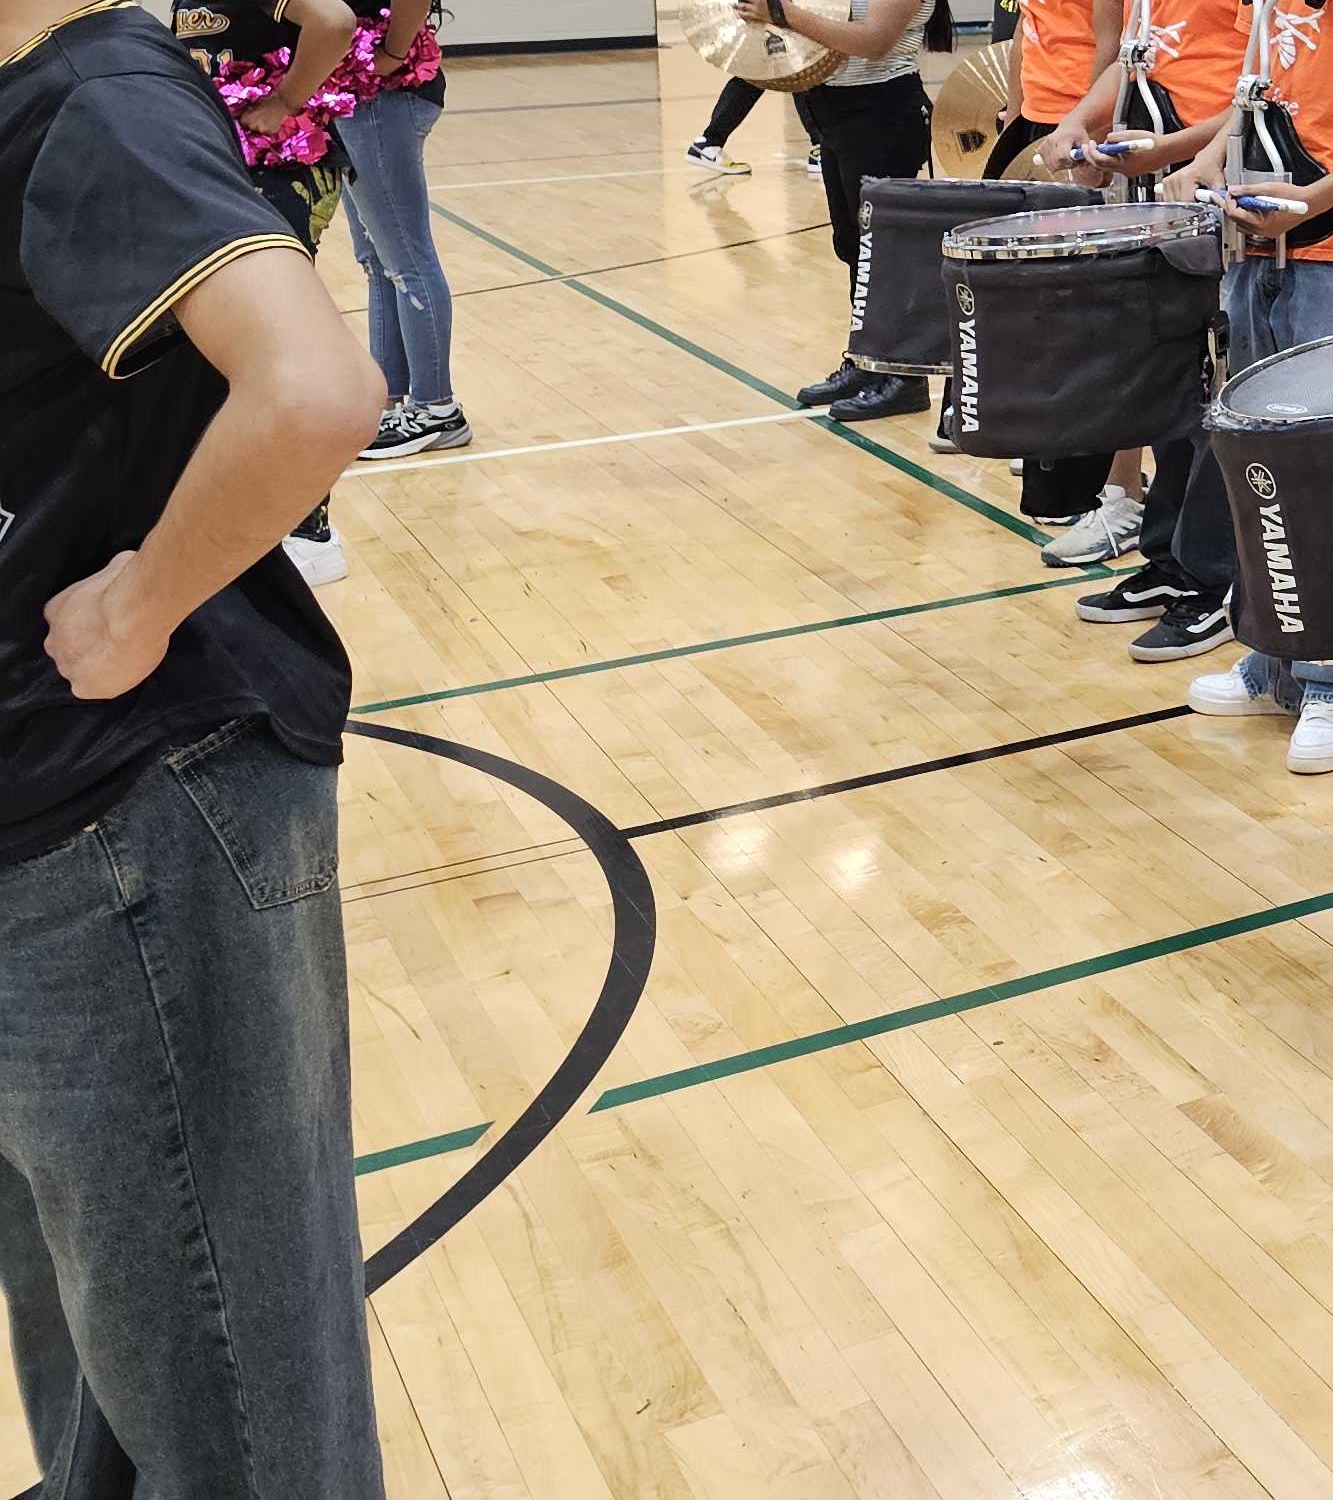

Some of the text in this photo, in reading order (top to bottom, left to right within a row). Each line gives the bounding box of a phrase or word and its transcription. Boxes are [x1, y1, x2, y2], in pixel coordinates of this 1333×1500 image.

[851, 231, 873, 332] YAMAHA
[958, 318, 980, 433] YAMAHA
[1259, 503, 1305, 633] YAMAHA
